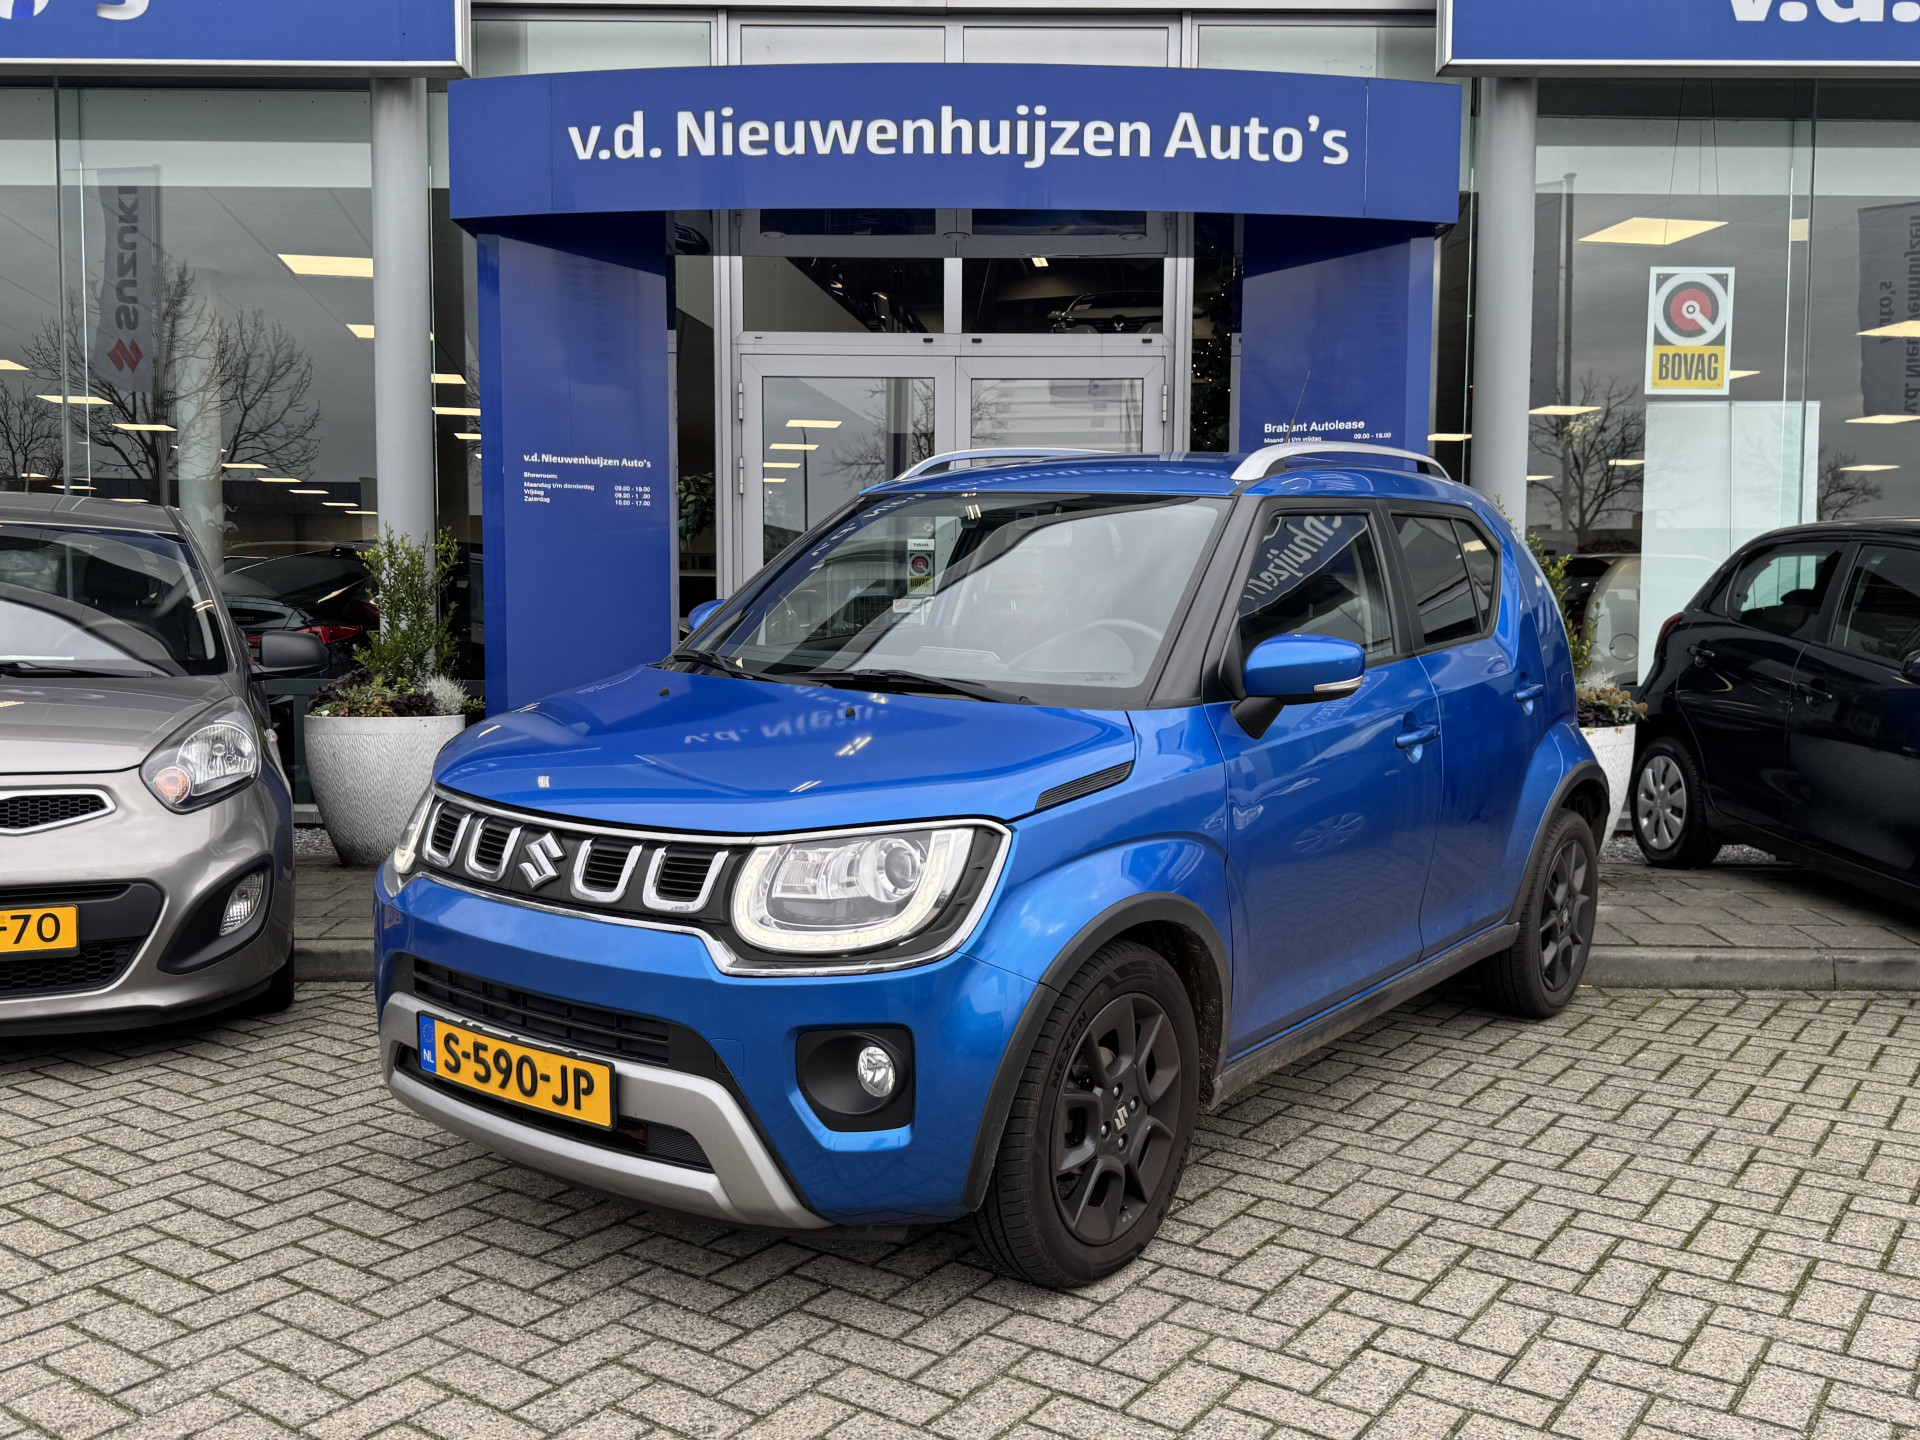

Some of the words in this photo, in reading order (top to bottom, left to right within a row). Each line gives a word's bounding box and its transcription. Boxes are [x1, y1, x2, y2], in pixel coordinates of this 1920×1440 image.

[567, 110, 662, 160] v.d.
[677, 104, 1151, 168] Nieuwenhuijzen
[1163, 112, 1349, 164] Auto's
[1658, 353, 1719, 381] BOVAG
[1264, 423, 1307, 434] Brabant
[1309, 420, 1365, 432] Autolease
[523, 452, 540, 463] v.d.
[541, 454, 619, 467] Nieuwenhuijzen
[621, 458, 652, 468] Auto's
[523, 481, 551, 490] Maandag
[563, 482, 594, 491] donderdag
[523, 488, 545, 496] Vrijdag
[523, 495, 551, 503] Zaterdag
[423, 1048, 434, 1064] NL
[1051, 1010, 1088, 1088] NEXEN
[443, 1032, 595, 1111] S-590-JP
